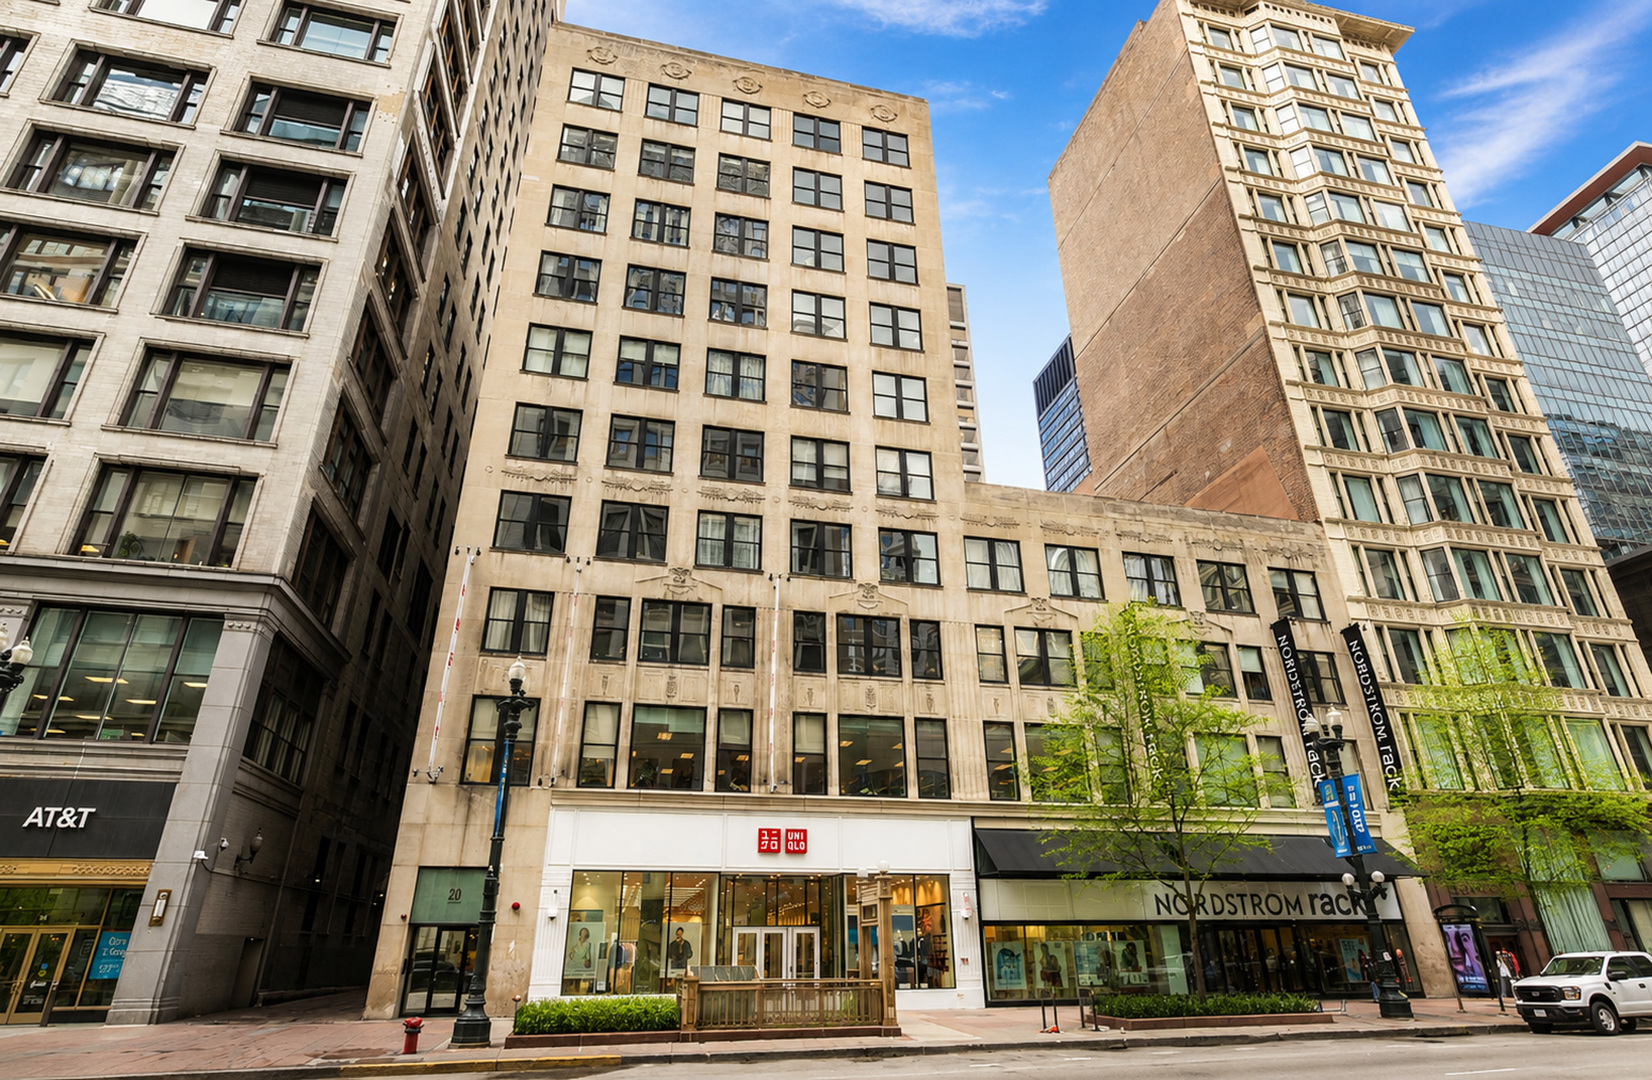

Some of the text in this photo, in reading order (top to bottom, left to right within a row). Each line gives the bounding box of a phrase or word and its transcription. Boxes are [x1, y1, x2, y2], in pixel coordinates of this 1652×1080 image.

[1349, 639, 1402, 791] NORDSTROM rack
[22, 806, 97, 828] AT&T
[448, 888, 462, 901] 20
[1154, 891, 1369, 916] NORDSTROM rack
